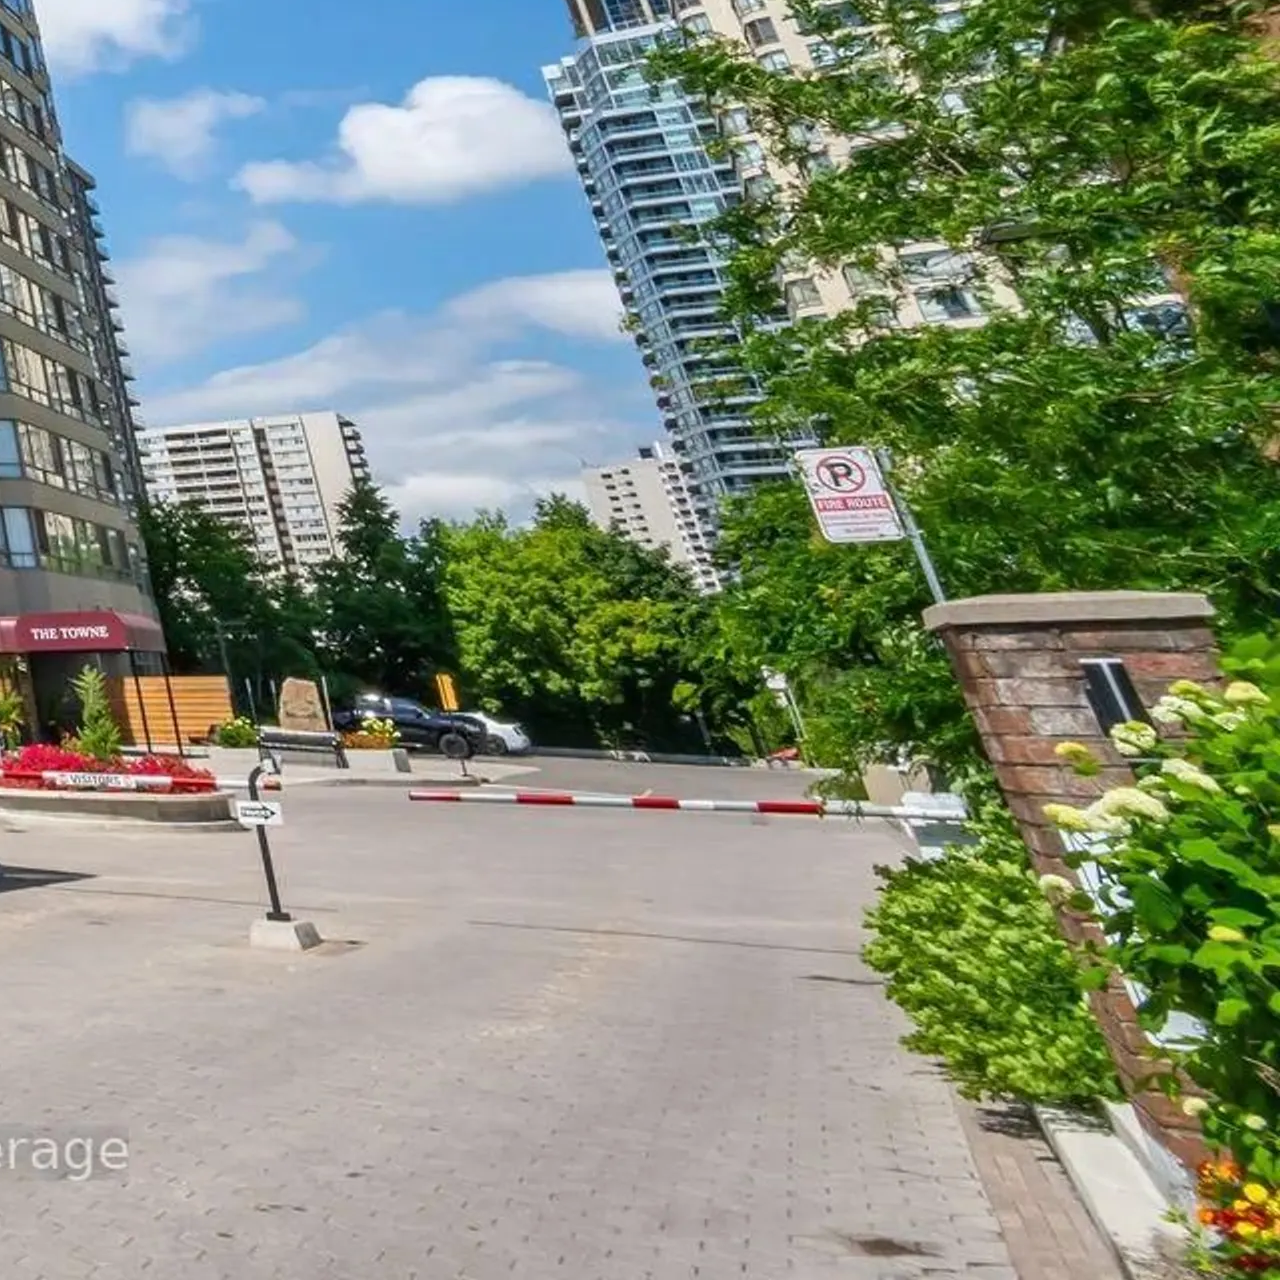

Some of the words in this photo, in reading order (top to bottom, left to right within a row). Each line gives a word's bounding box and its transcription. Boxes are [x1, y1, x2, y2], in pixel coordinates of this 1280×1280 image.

[817, 500, 845, 512] FIRE
[847, 497, 887, 510] ROUTE
[30, 628, 58, 639] THE
[60, 626, 109, 639] TOWNE
[70, 774, 122, 786] VISITORS
